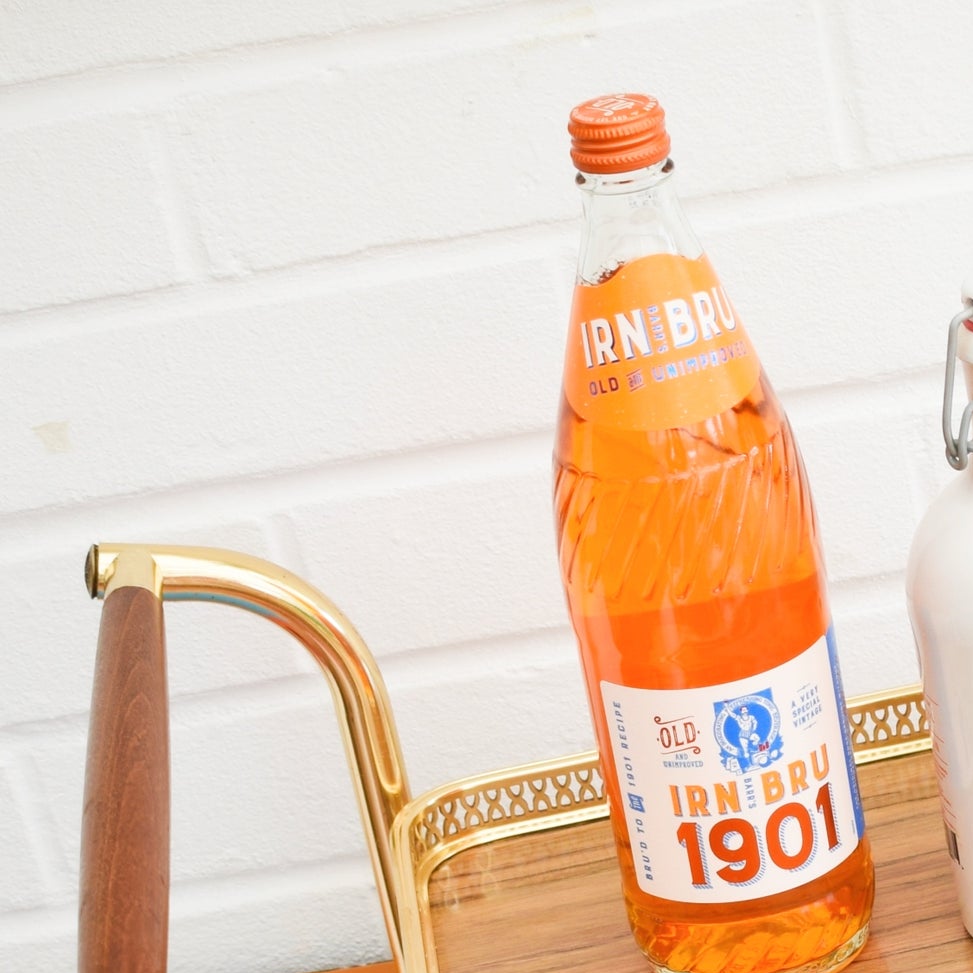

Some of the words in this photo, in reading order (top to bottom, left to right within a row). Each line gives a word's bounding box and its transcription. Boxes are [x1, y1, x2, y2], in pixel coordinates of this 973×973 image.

[580, 308, 653, 368] IRN
[662, 286, 736, 348] BRU
[589, 377, 619, 396] OLD
[652, 341, 747, 382] UNIMPROVED
[791, 699, 796, 708] A
[800, 686, 819, 703] VERY
[792, 698, 820, 718] SPECIAL
[613, 701, 629, 750] RECIPE
[793, 706, 822, 728] VINTAGE
[659, 721, 697, 748] OLD
[663, 760, 704, 768] UNIMPROVED
[675, 753, 688, 761] AND
[624, 757, 636, 787] 1901
[669, 780, 741, 817] IRN
[760, 744, 830, 805] BRU
[637, 818, 645, 833] TO
[676, 782, 842, 890] 1901
